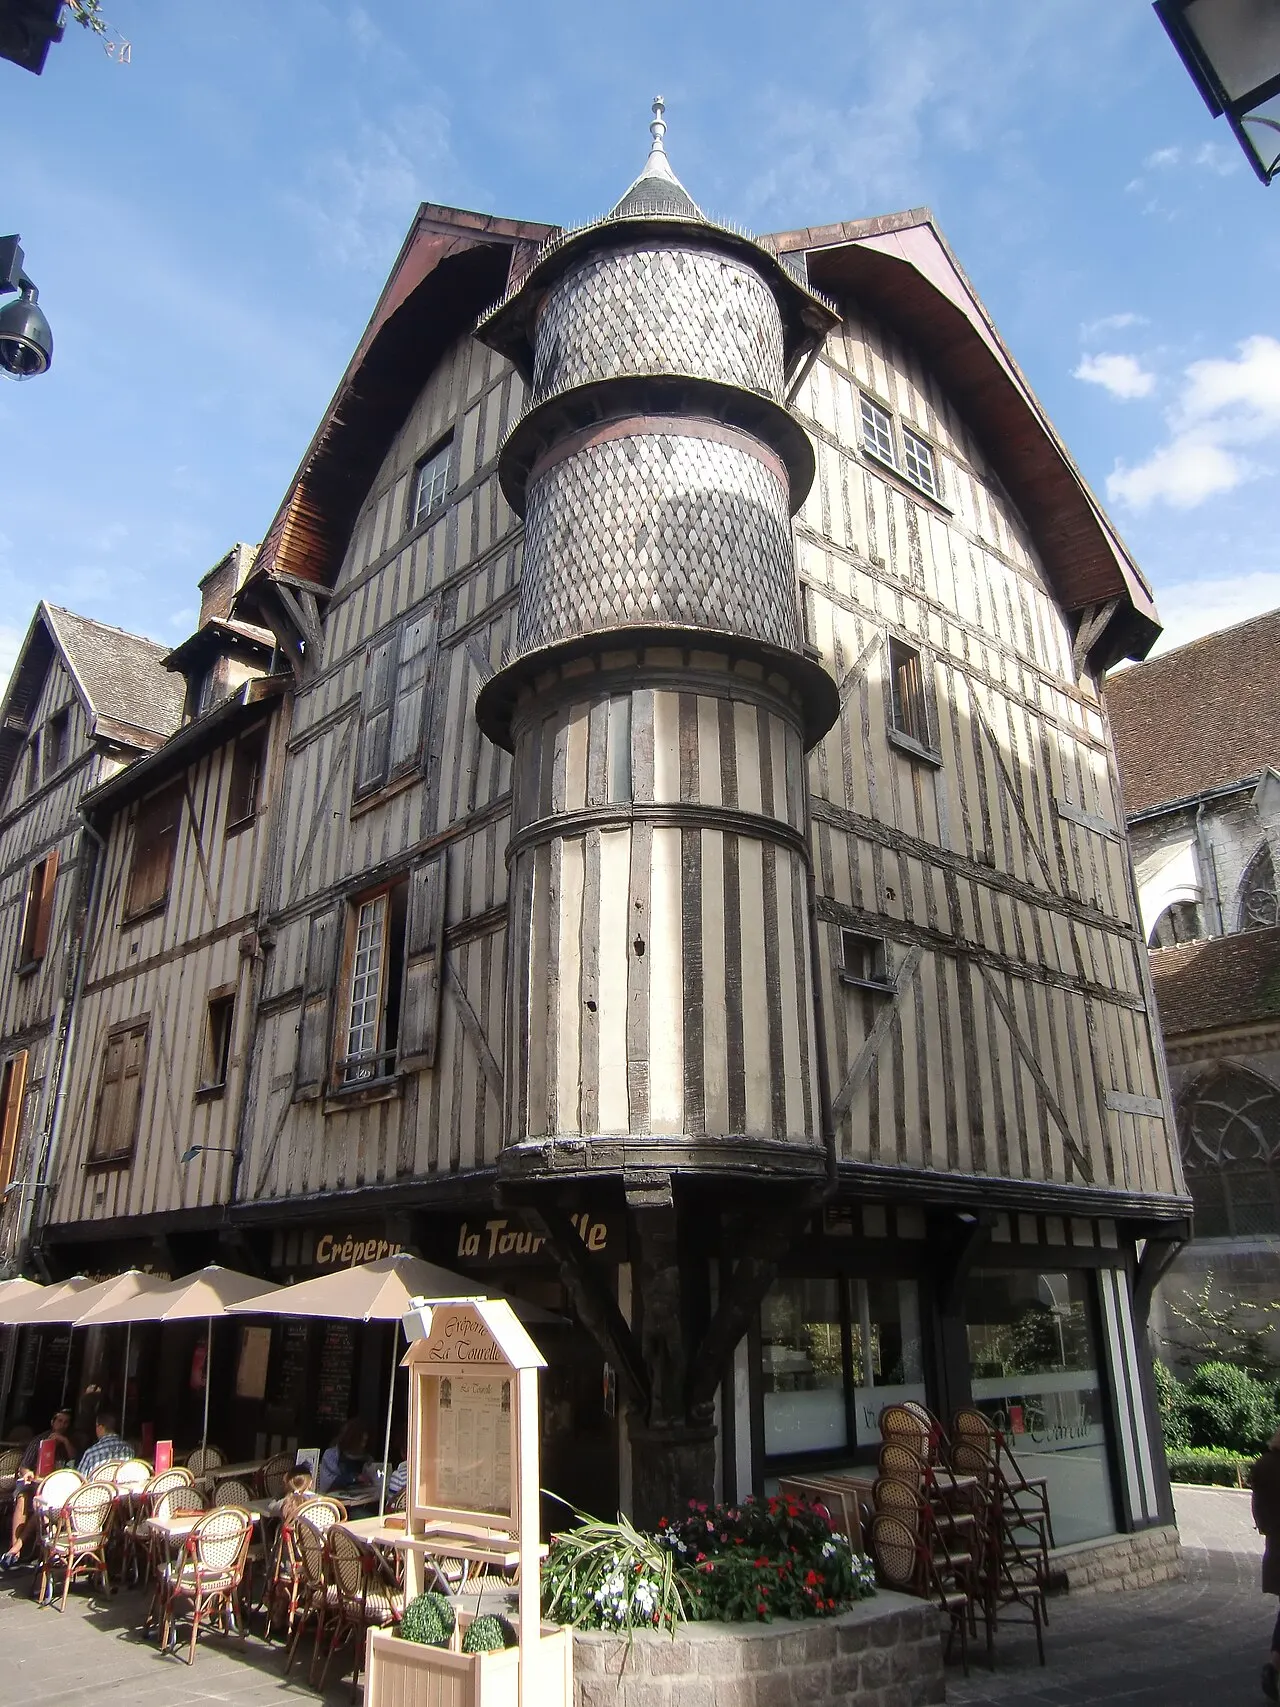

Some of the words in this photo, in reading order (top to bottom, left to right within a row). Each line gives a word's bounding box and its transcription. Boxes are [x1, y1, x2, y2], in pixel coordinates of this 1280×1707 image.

[457, 1222, 481, 1257] la
[428, 1339, 451, 1361] La
[454, 1339, 502, 1362] Tourelle
